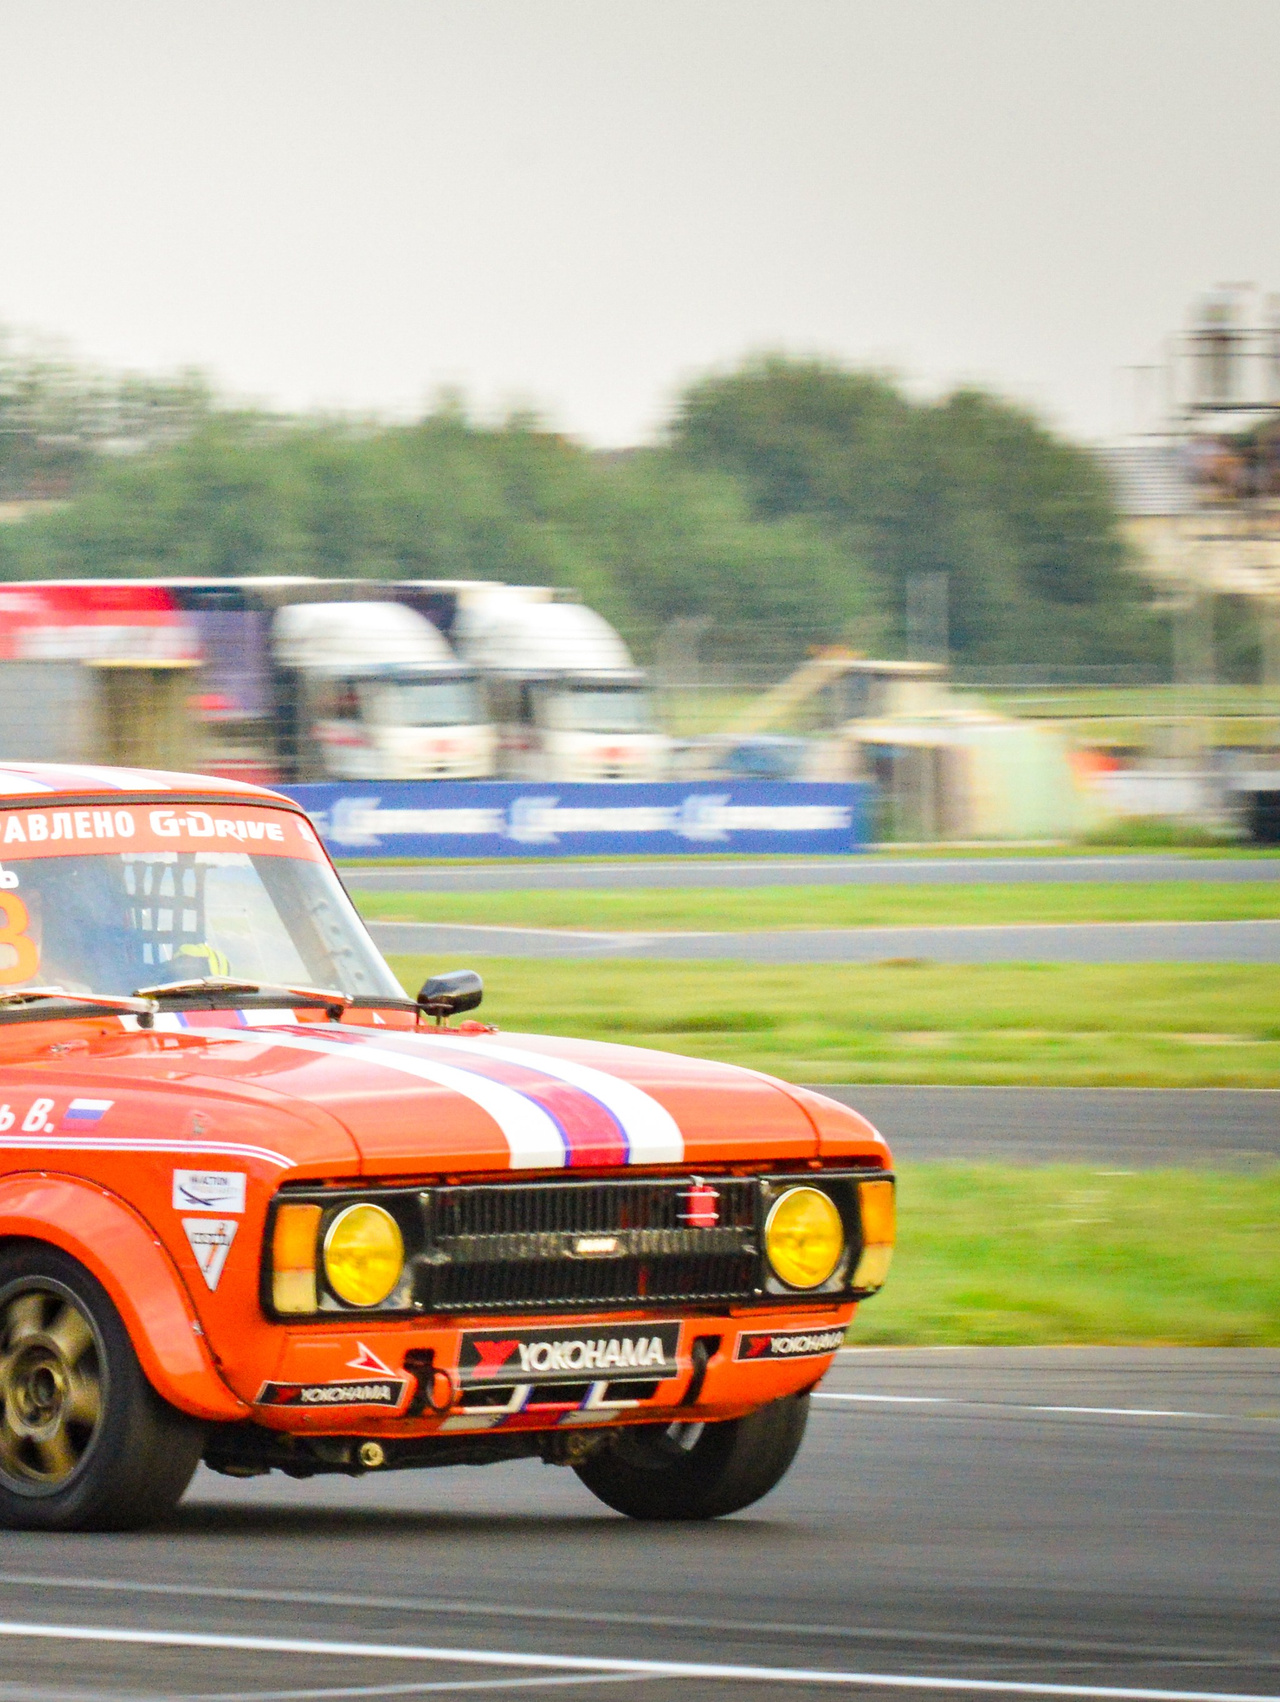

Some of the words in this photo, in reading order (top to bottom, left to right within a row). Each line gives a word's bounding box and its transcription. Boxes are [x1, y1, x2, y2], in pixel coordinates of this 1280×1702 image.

[21, 1097, 56, 1134] В.
[518, 1336, 667, 1373] YOKOHAMA
[771, 1330, 844, 1354] YOKOHAMA
[301, 1384, 392, 1403] YOKOHAMA
